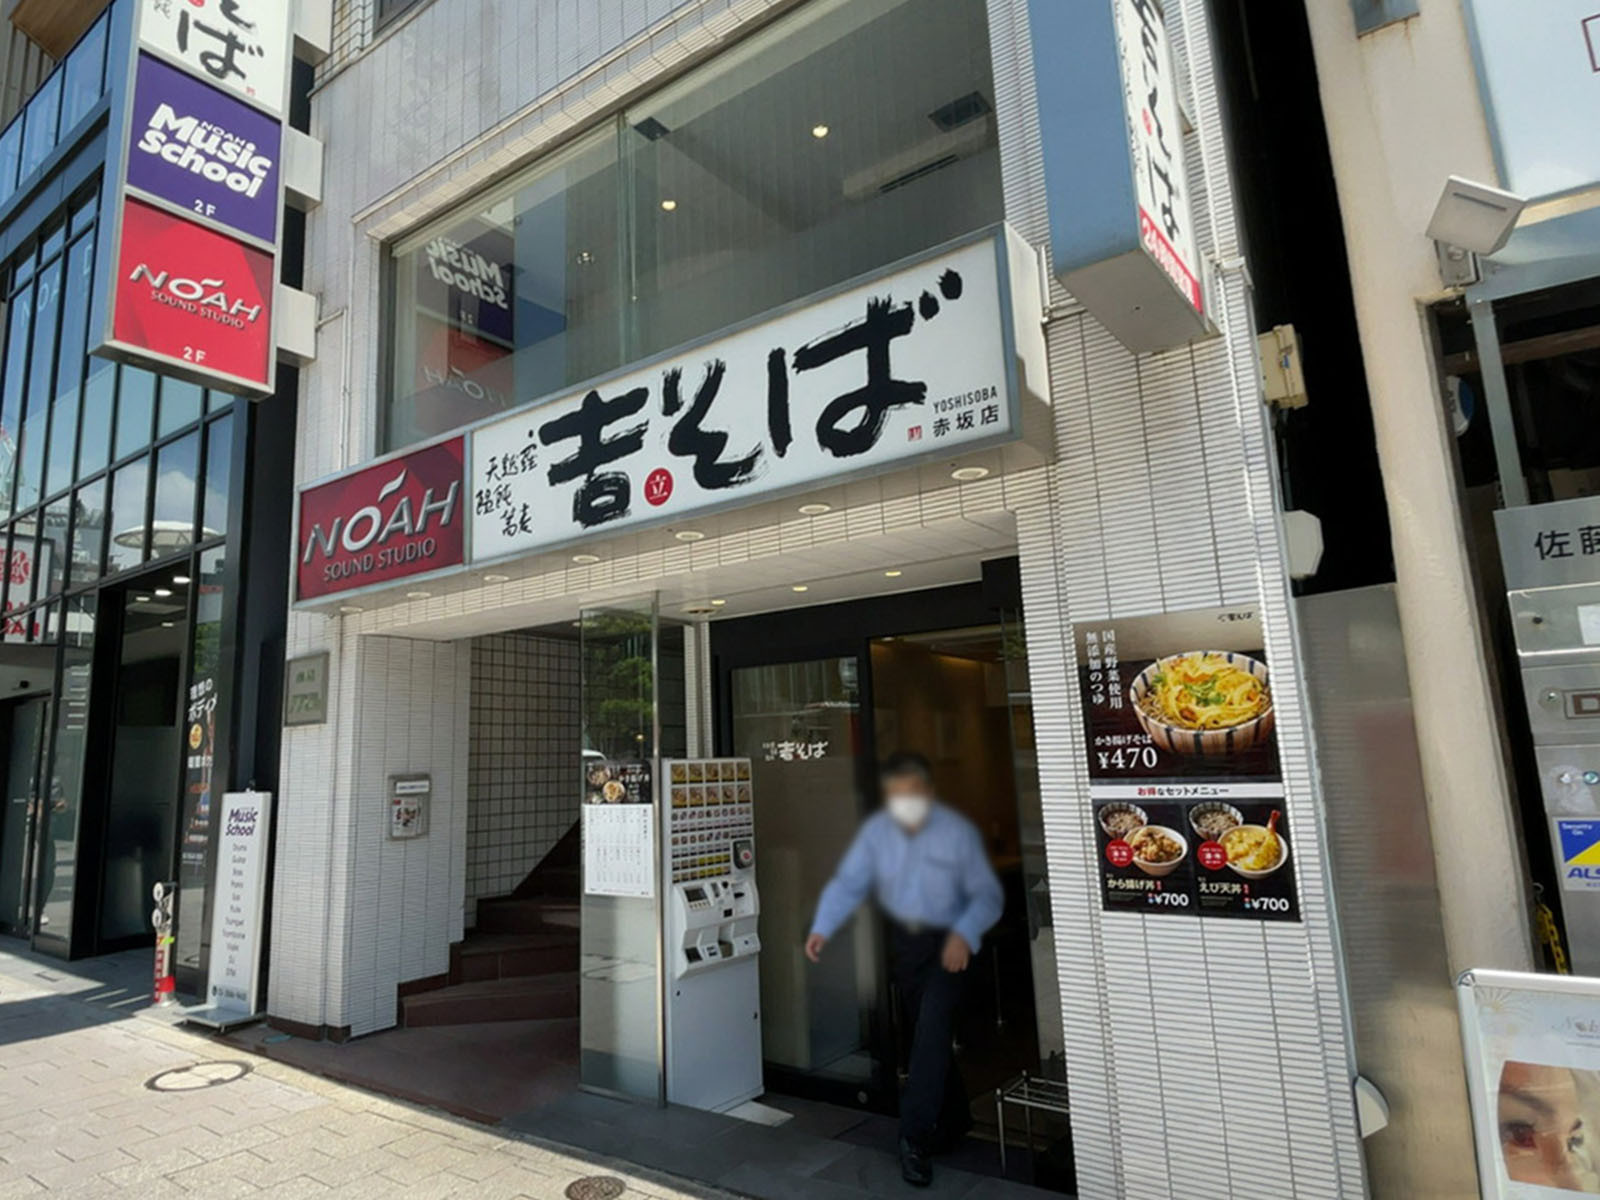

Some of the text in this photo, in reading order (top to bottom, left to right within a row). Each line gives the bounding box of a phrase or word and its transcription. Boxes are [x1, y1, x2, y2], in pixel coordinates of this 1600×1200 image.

[148, 103, 273, 178] Music
[137, 129, 264, 198] School
[194, 200, 216, 217] 2F
[129, 264, 262, 322] NOAH
[151, 290, 245, 329] SOUND STUDIO
[183, 346, 207, 363] 2F
[538, 268, 963, 530] 吉そば
[933, 386, 998, 414] YOSHISOBA
[932, 404, 1000, 437] 赤坂店
[303, 469, 459, 563] NOAH
[323, 537, 436, 582] SOUND STUDIO
[777, 741, 829, 761] 吉そば
[1097, 747, 1158, 769] ¥470
[1137, 786, 1229, 796] お得なセットメニュー
[229, 807, 258, 823] Music
[225, 823, 255, 837] School
[1154, 892, 1190, 907] ¥700
[1251, 897, 1290, 912] ¥700
